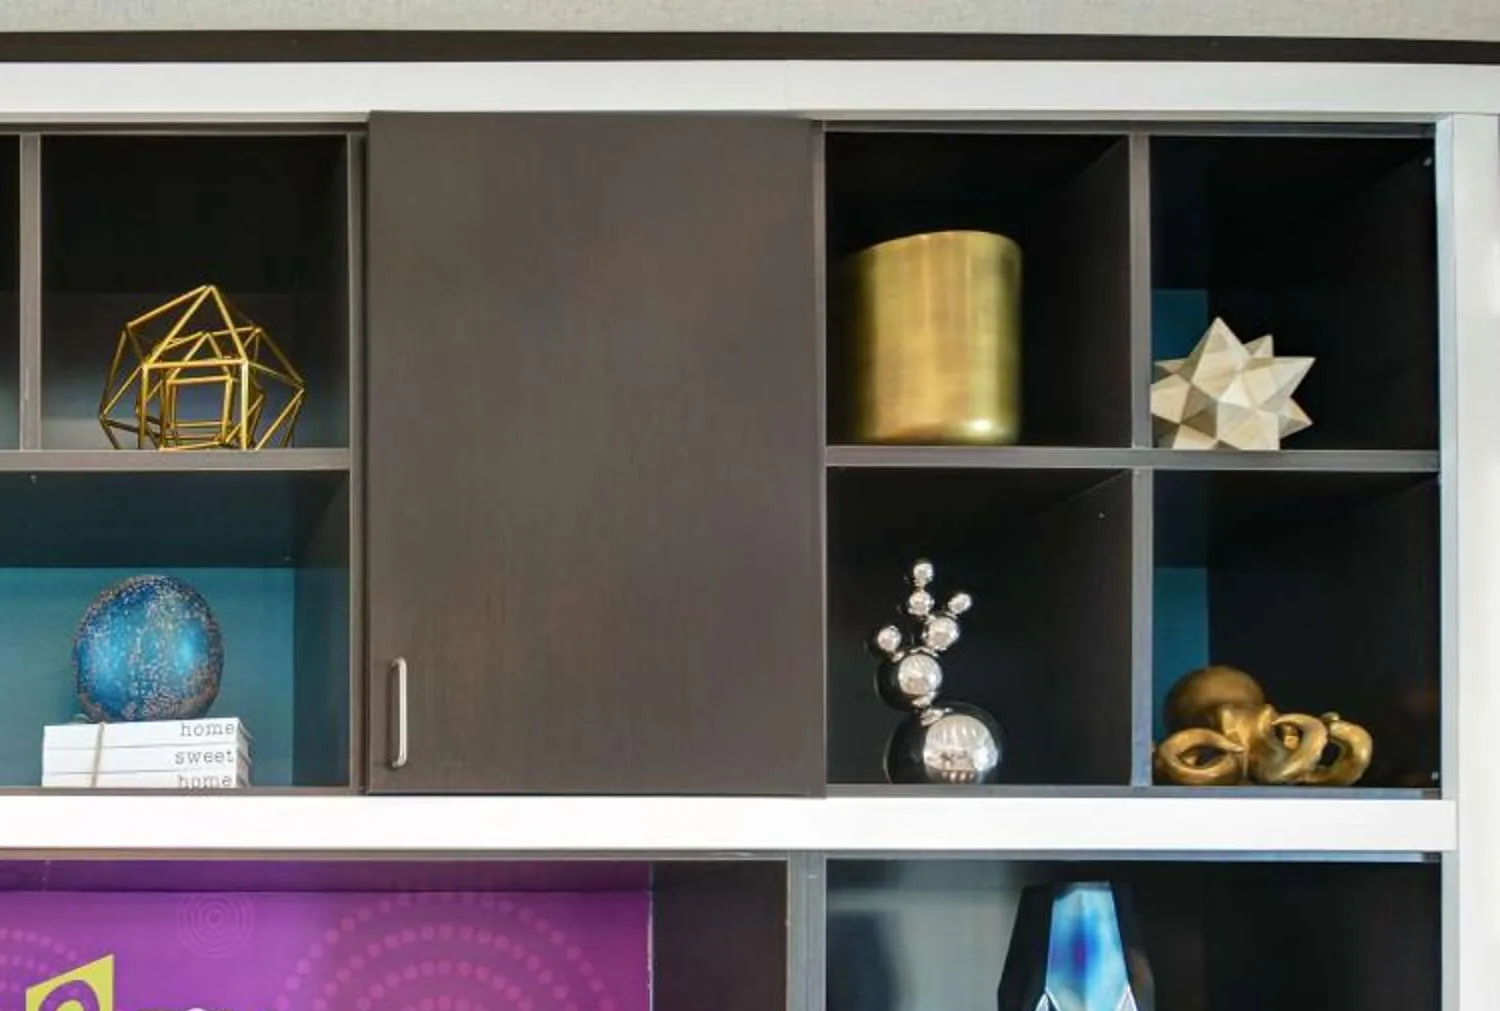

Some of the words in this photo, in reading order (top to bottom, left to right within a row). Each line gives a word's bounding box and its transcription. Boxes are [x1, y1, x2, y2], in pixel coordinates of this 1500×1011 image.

[180, 723, 235, 737] home
[174, 750, 235, 764] sweet
[178, 774, 232, 789] home
